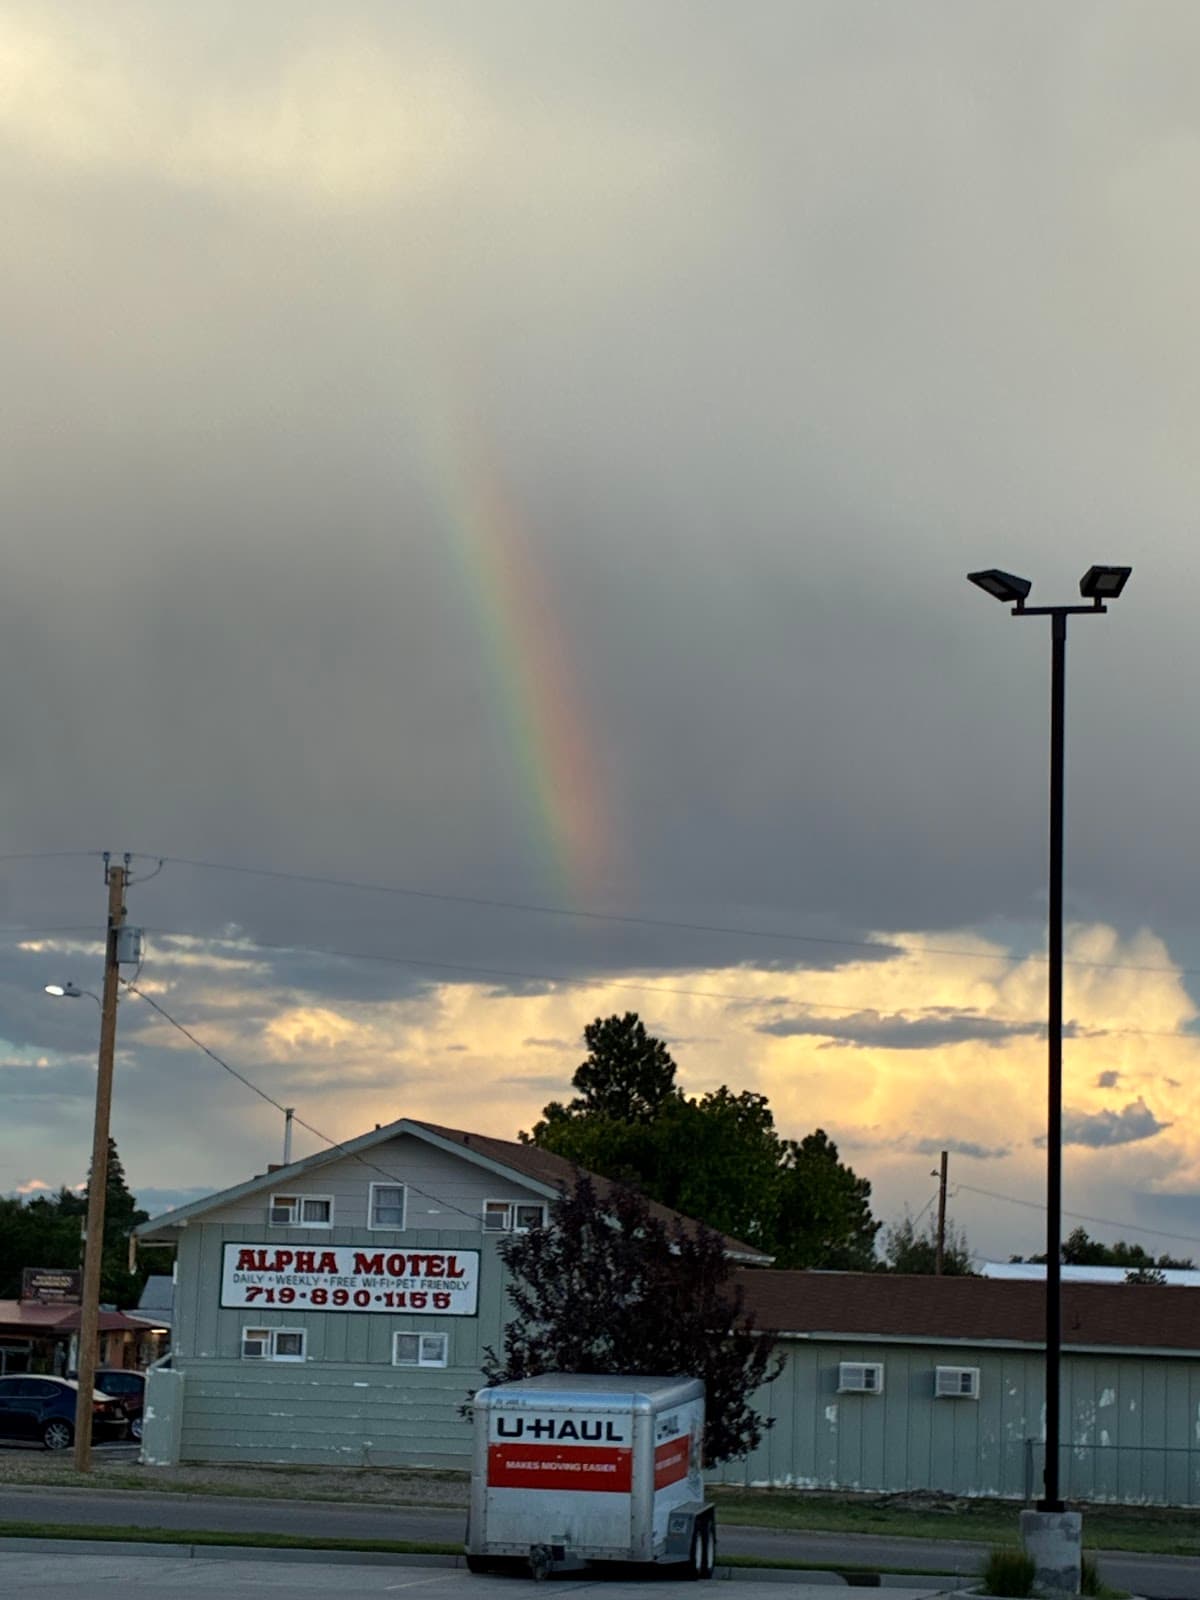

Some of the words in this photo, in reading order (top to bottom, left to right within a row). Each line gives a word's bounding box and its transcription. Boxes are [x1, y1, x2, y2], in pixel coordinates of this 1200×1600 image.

[235, 1248, 339, 1274] ALPHA
[352, 1252, 465, 1278] MOTEL
[233, 1273, 265, 1284] DAILY
[275, 1274, 320, 1286] WEEKLY
[330, 1276, 356, 1287] FREE
[396, 1279, 415, 1289] PET
[420, 1279, 470, 1291] FRIENDLY
[497, 1417, 624, 1441] U-HAUL
[505, 1460, 540, 1471] MAKES
[541, 1462, 581, 1472] MOVING
[582, 1463, 617, 1473] EASIER
